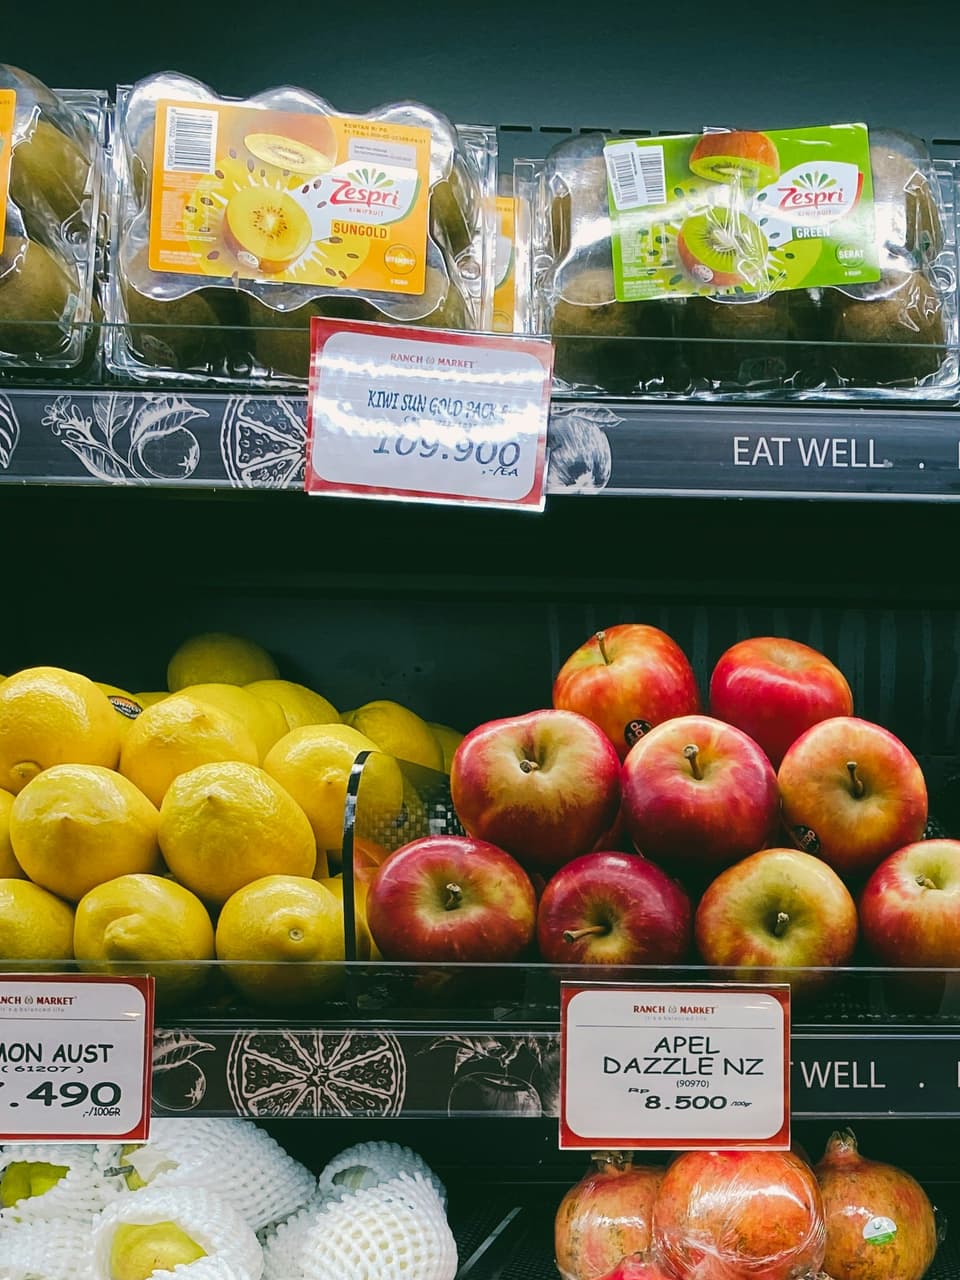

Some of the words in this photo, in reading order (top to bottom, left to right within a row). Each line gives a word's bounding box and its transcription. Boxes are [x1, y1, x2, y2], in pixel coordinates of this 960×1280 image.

[330, 179, 400, 208] Zespri
[777, 186, 844, 211] Zespri
[333, 222, 387, 239] SUNGOLD
[796, 226, 830, 238] GREEN
[390, 353, 423, 364] RANCH
[438, 357, 474, 369] MARKET
[367, 390, 400, 409] KIWI
[400, 393, 427, 413] SUN
[429, 397, 463, 416] GOLD
[733, 437, 791, 466] EAT
[798, 438, 887, 468] WELL
[36, 997, 74, 1005] MARKET
[633, 1005, 665, 1013] RANCH
[680, 1006, 715, 1014] MARKET
[52, 1044, 114, 1064] AUST
[653, 1036, 720, 1054] APEL
[603, 1056, 714, 1076] DAZZLE
[723, 1058, 764, 1076] NZ
[801, 1061, 886, 1089] WELL
[676, 1079, 710, 1089] (90970)
[0, 1081, 122, 1108] .490
[644, 1095, 728, 1110] 8.500
